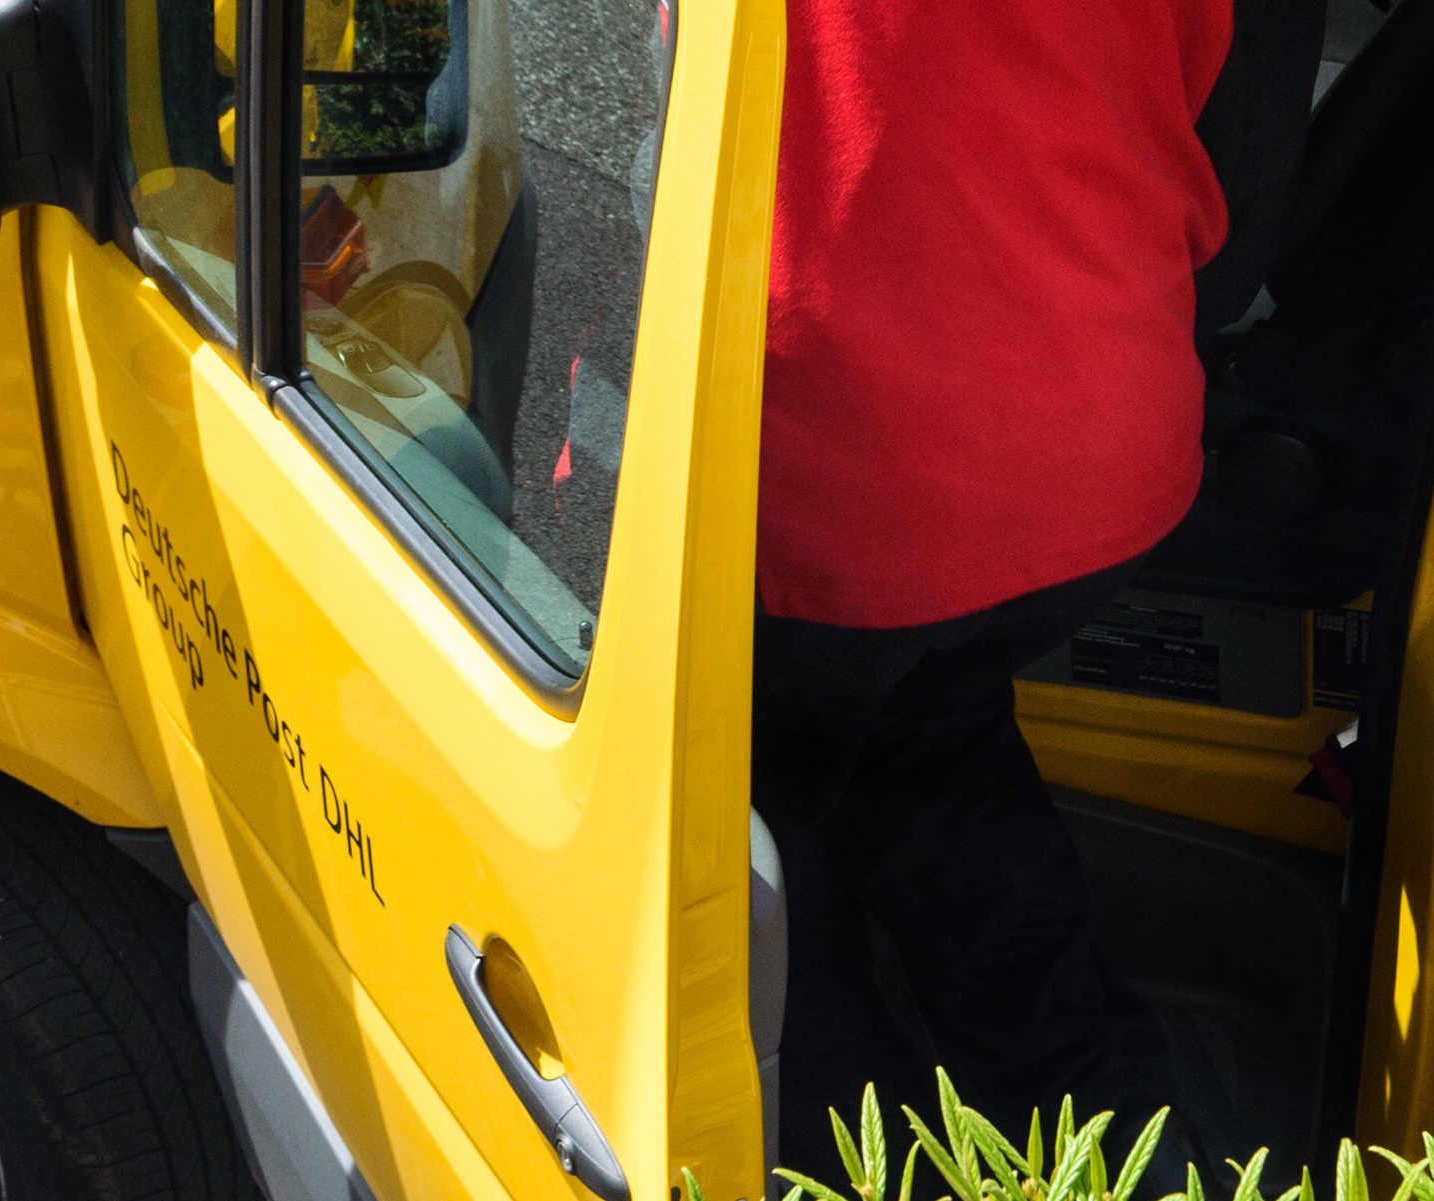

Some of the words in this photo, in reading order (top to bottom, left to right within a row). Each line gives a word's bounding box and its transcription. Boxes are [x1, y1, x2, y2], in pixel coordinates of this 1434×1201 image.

[110, 438, 238, 680] Deutsche
[243, 646, 310, 793] Post
[319, 763, 386, 909] DHL
[122, 523, 205, 691] Group
